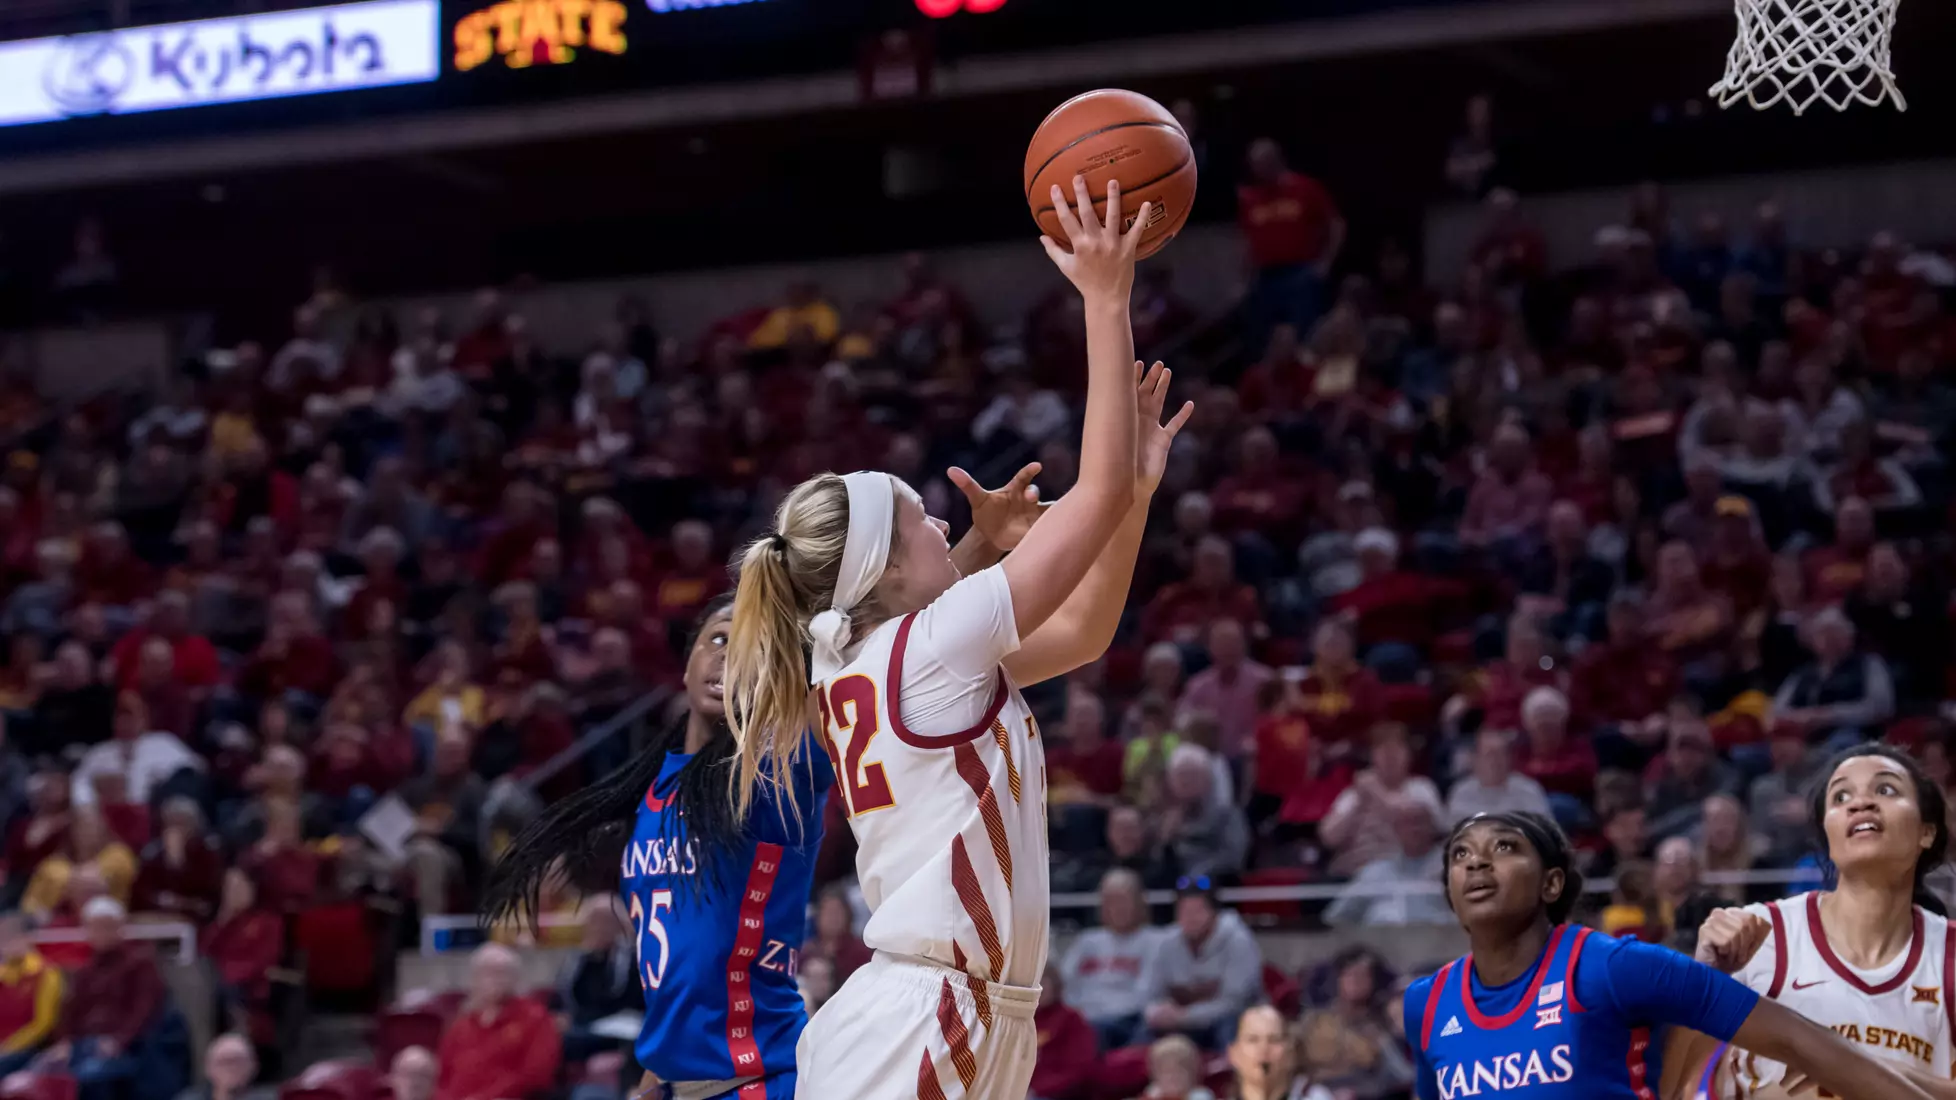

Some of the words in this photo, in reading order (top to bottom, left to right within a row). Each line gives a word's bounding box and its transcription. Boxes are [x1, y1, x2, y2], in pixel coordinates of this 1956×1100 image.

[455, 0, 627, 71] STATE
[150, 22, 386, 91] Kubota
[757, 861, 775, 873] KU
[749, 890, 766, 903] KU
[745, 918, 760, 930] KU
[730, 971, 745, 982] KU
[734, 1000, 750, 1012] KU
[731, 1027, 747, 1038] KU
[1864, 1025, 1934, 1065] STATE
[738, 1052, 755, 1064] KU
[1436, 1044, 1574, 1100] KANSAS
